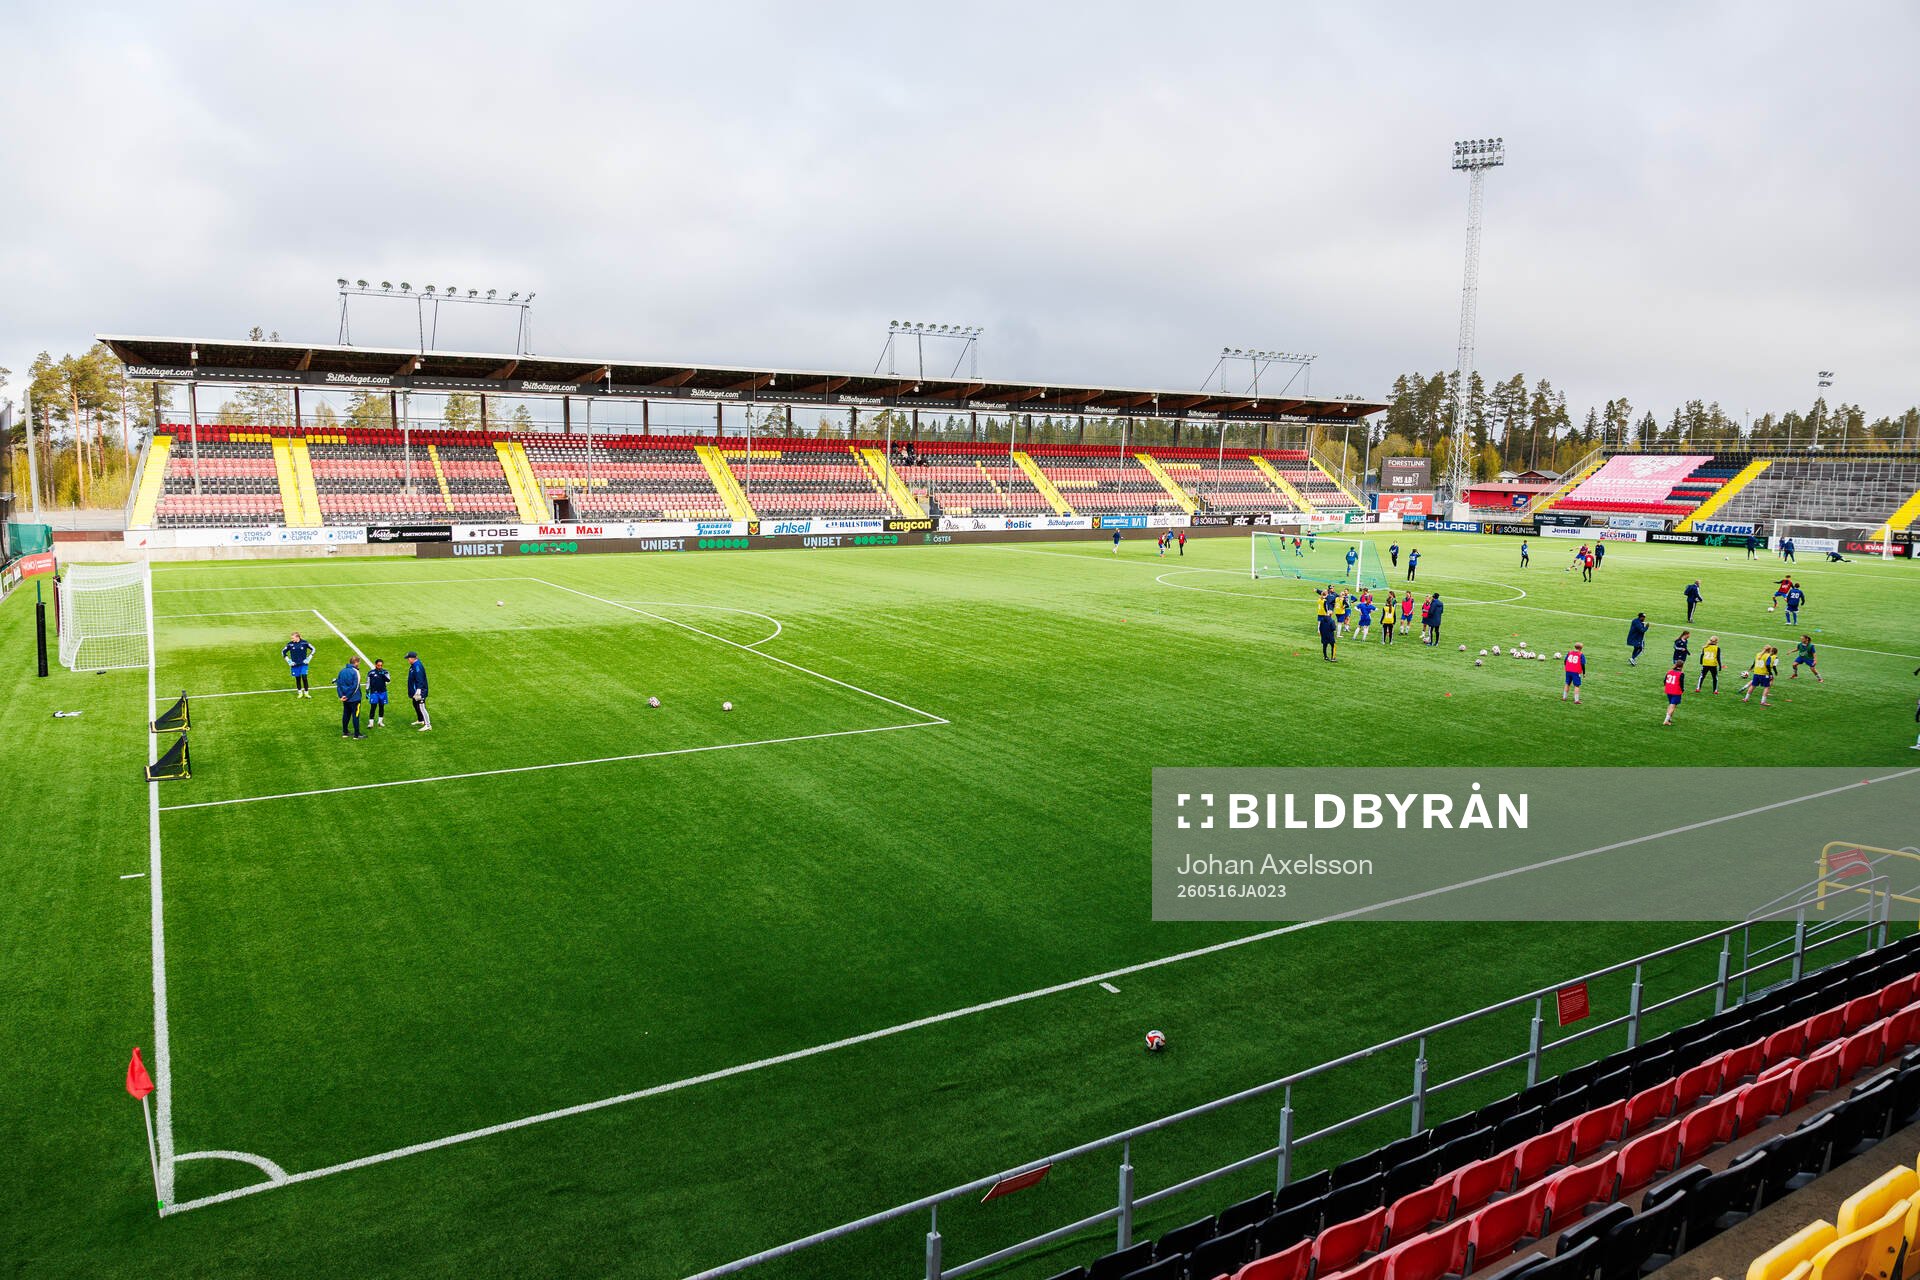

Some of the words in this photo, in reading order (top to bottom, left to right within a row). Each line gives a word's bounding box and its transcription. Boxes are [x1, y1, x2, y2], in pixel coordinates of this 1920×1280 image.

[326, 372, 390, 384] Bilbolaget.com
[774, 522, 811, 534] ahlsell
[889, 521, 932, 532] engcon
[1427, 521, 1477, 532] POLARIS
[1694, 522, 1752, 535] Wattacus
[478, 529, 518, 537] TOBE
[640, 539, 685, 550] UNIBET
[803, 536, 842, 546] UNIBET
[452, 543, 504, 555] UNIBET
